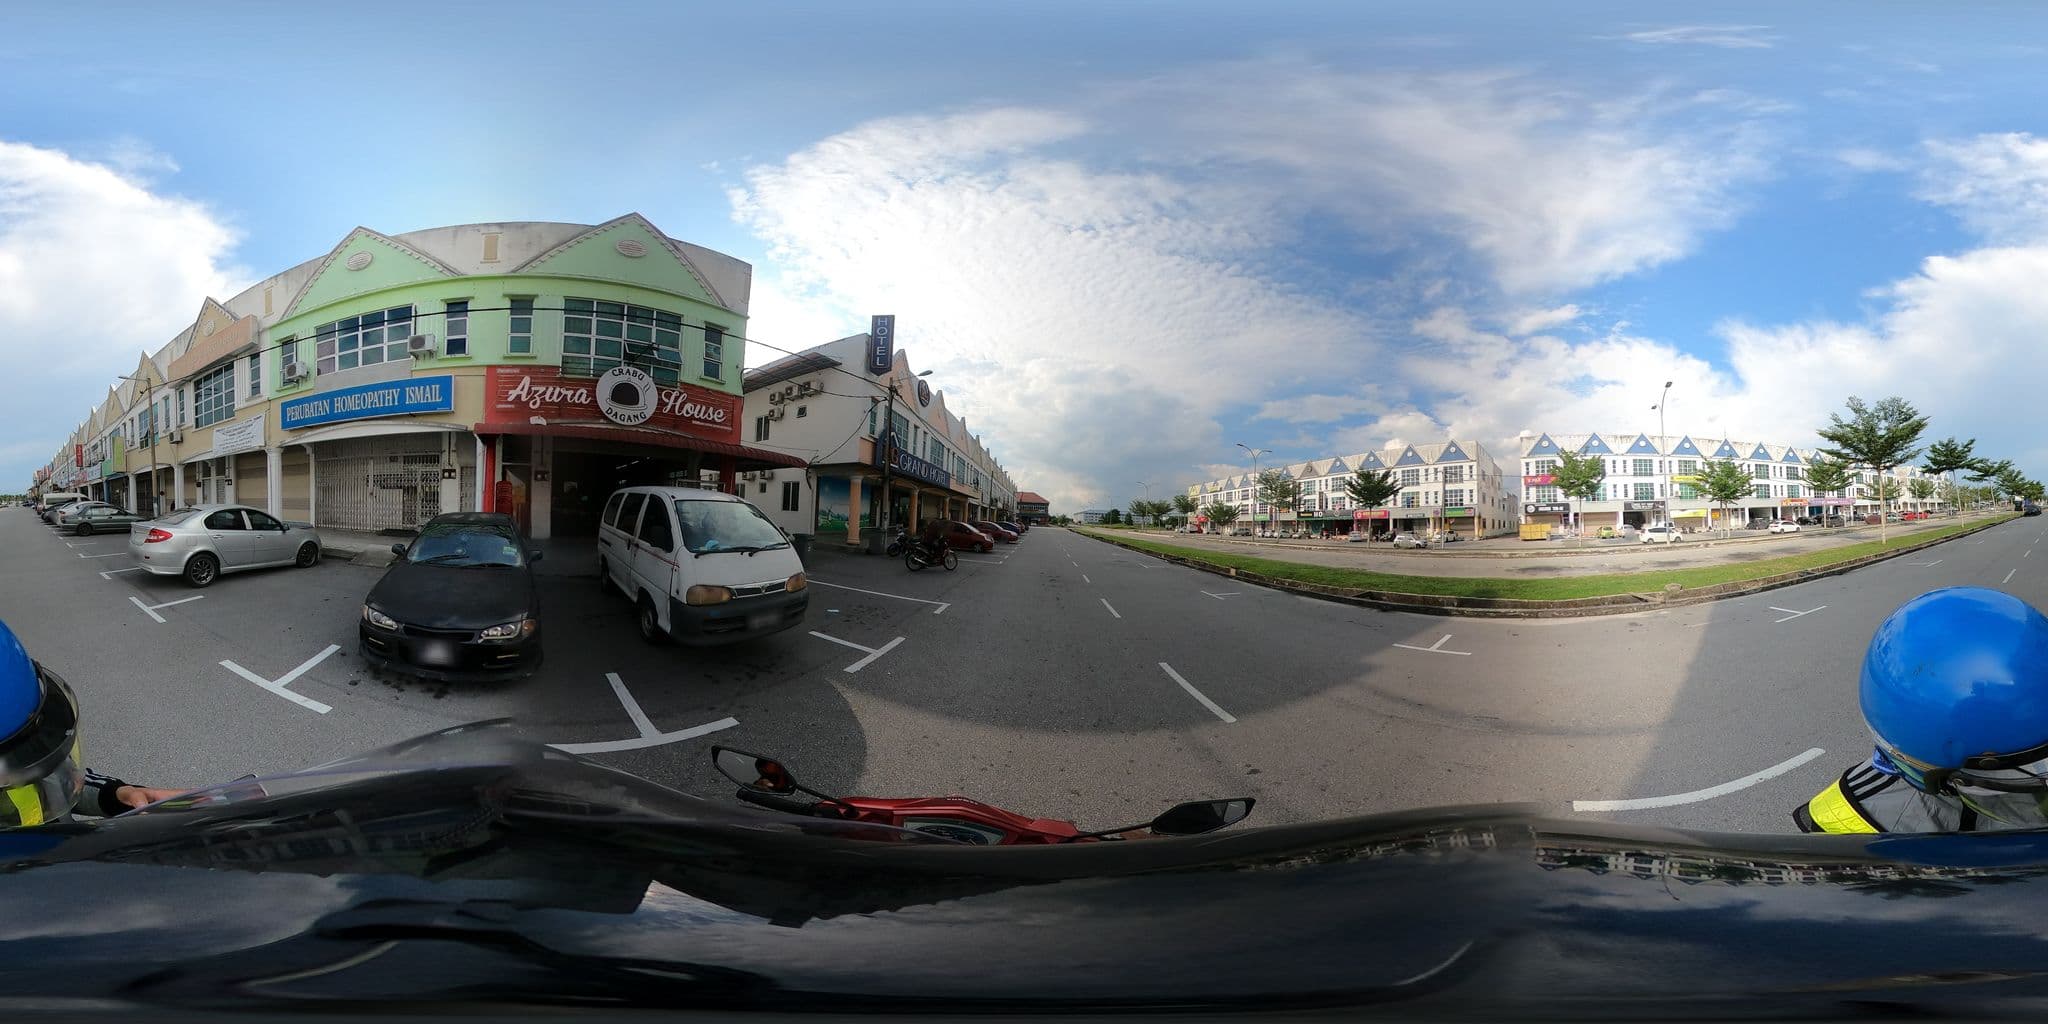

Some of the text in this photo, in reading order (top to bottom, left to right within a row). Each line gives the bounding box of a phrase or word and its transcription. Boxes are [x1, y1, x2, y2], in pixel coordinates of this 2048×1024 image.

[876, 318, 888, 366] HOTEL
[286, 384, 443, 422] PERUBATAN HOMEOPATHY ISMAIL
[507, 375, 727, 423] Azura House
[605, 407, 647, 423] DAGANG
[900, 453, 929, 478] GRAND
